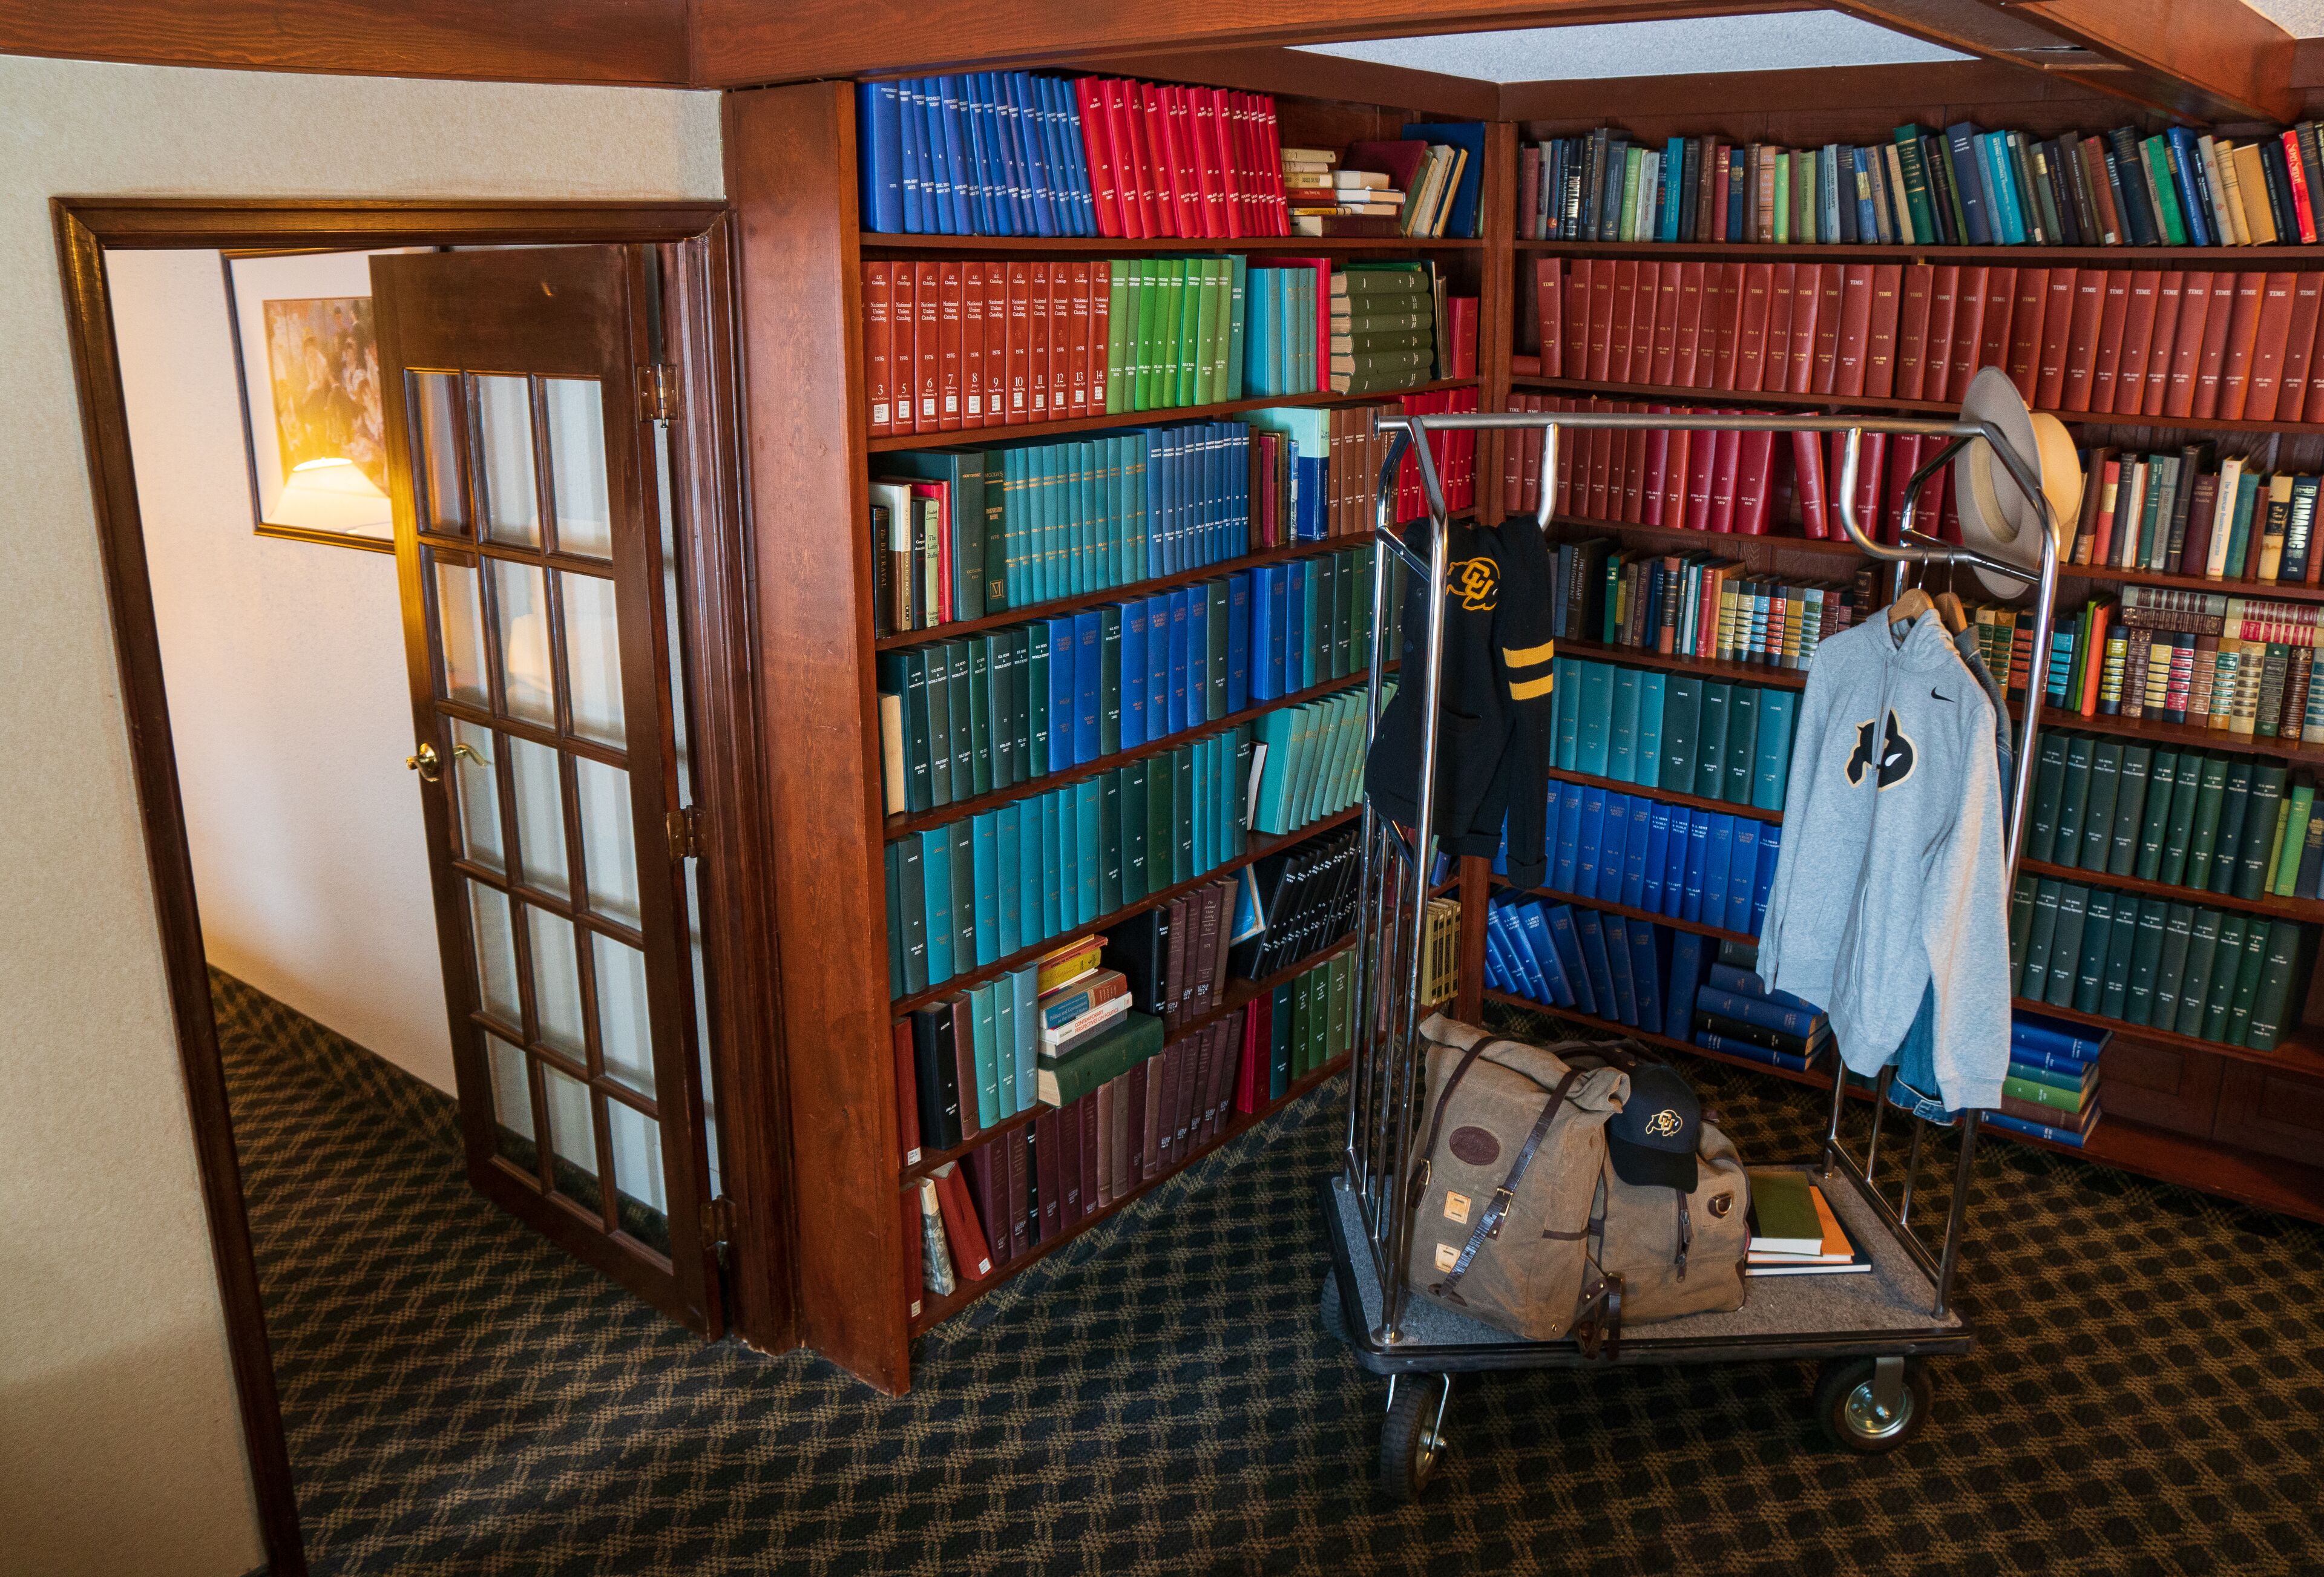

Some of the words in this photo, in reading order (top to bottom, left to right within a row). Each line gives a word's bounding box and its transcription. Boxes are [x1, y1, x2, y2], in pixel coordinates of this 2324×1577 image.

[948, 374, 953, 384] 7
[973, 373, 977, 382] 8
[1038, 375, 1043, 384] 11
[1057, 373, 1063, 383] 12
[1076, 372, 1083, 382] 13
[1096, 370, 1103, 379] 14
[927, 378, 932, 387] 6
[994, 377, 998, 387] 9
[1015, 376, 1023, 387] 10
[878, 385, 883, 395] 3
[902, 383, 906, 393] 5
[2221, 490, 2229, 511] American
[2217, 513, 2226, 533] Business
[2289, 496, 2311, 549] ALMANAC
[1568, 548, 1578, 599] ESTABLISHMENT
[1462, 562, 1494, 600] CU
[1075, 1009, 1103, 1027] CONTEMPORARY
[1075, 1019, 1098, 1033] PERSPECTIVES
[1105, 1008, 1118, 1018] POLITICS
